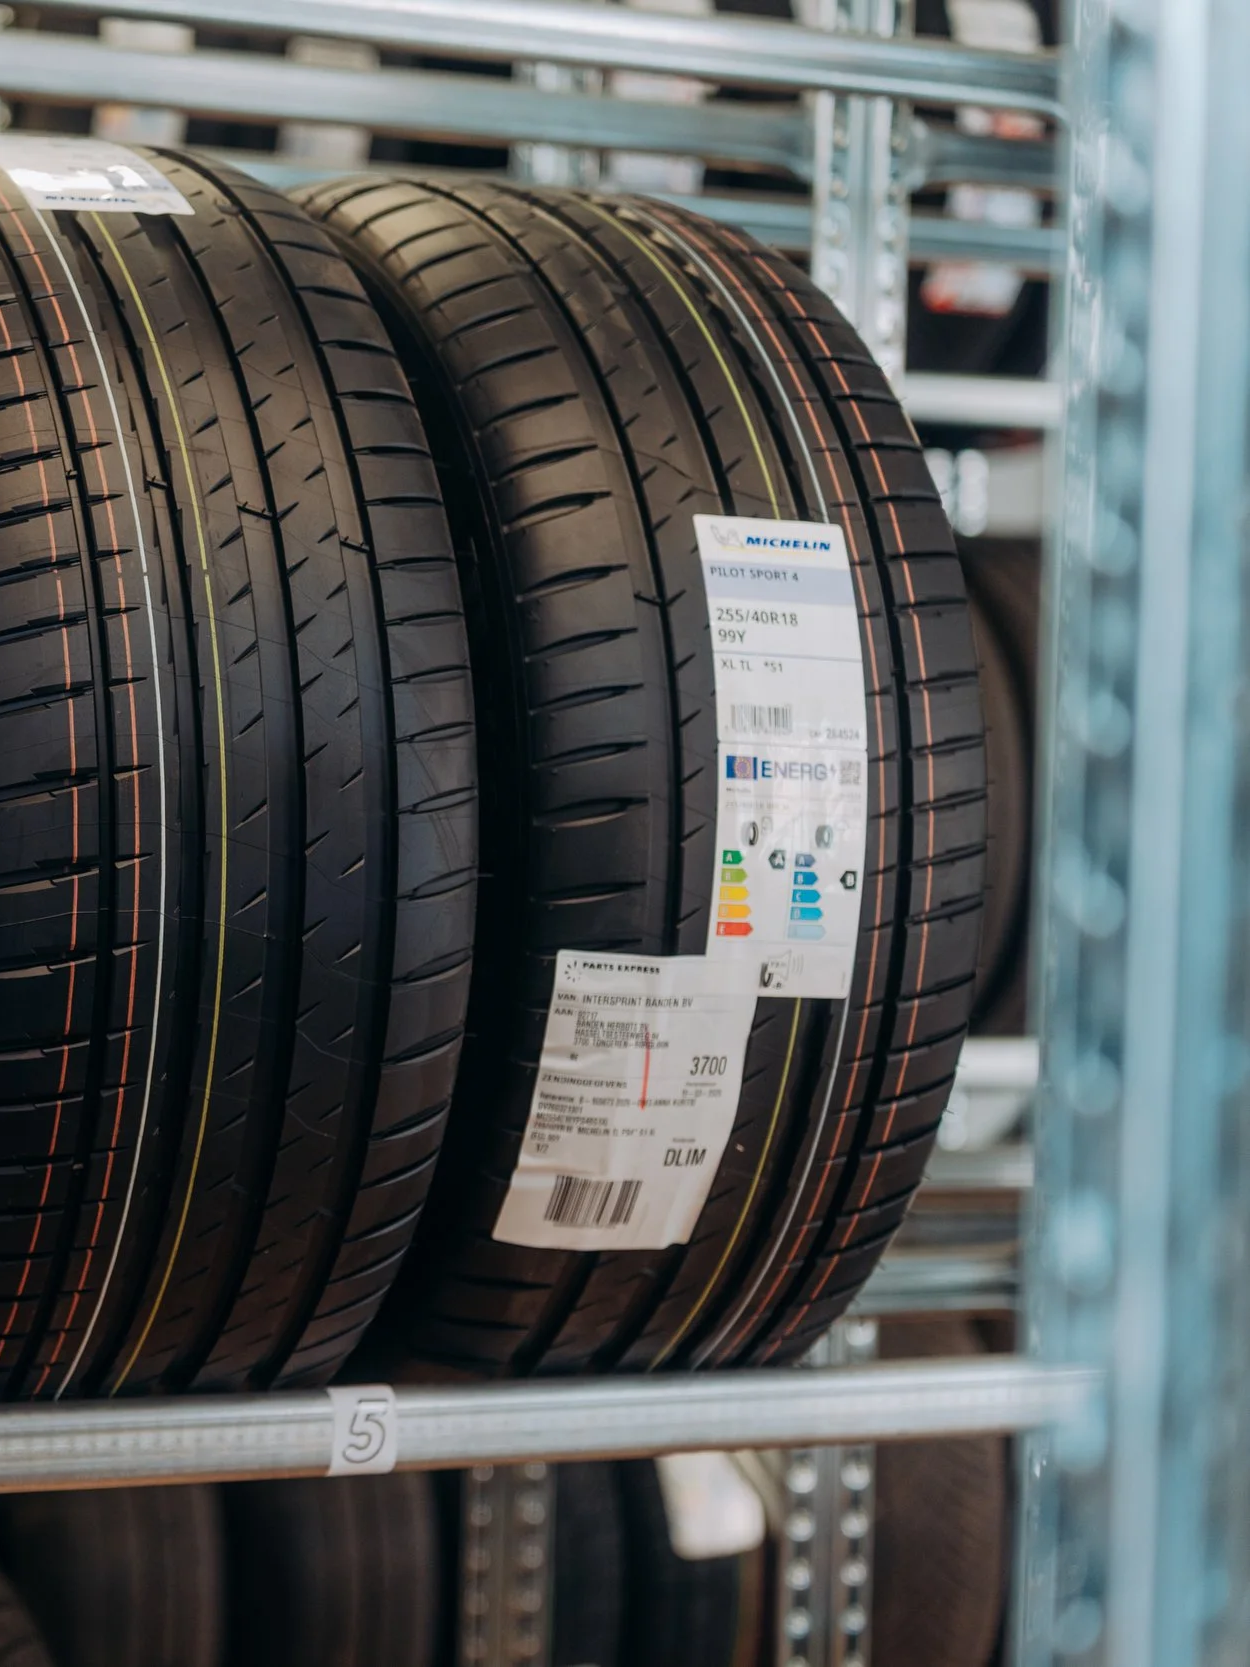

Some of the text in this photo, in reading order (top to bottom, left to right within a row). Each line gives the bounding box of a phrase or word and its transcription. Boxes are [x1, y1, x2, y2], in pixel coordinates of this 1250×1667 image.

[746, 537, 831, 551] MICHELIN
[710, 567, 799, 582] PILOT SPORT 4
[717, 608, 798, 626] 255/40R18
[719, 629, 747, 643] 99Y
[721, 659, 737, 670] XL
[740, 660, 753, 671] TL
[762, 761, 827, 780] ENERG
[726, 853, 732, 861] A
[775, 855, 783, 867] A
[799, 856, 805, 866] A
[797, 874, 803, 883] B
[846, 873, 855, 886] B
[796, 891, 801, 901] C
[582, 961, 660, 975] PARTS EXPRESS
[583, 995, 642, 1007] INTERSPRINT
[645, 997, 680, 1008] BANDEN
[682, 998, 693, 1008] BV
[690, 1056, 727, 1076] 3700
[664, 1148, 706, 1167] DLIM
[342, 1398, 388, 1464] 5
